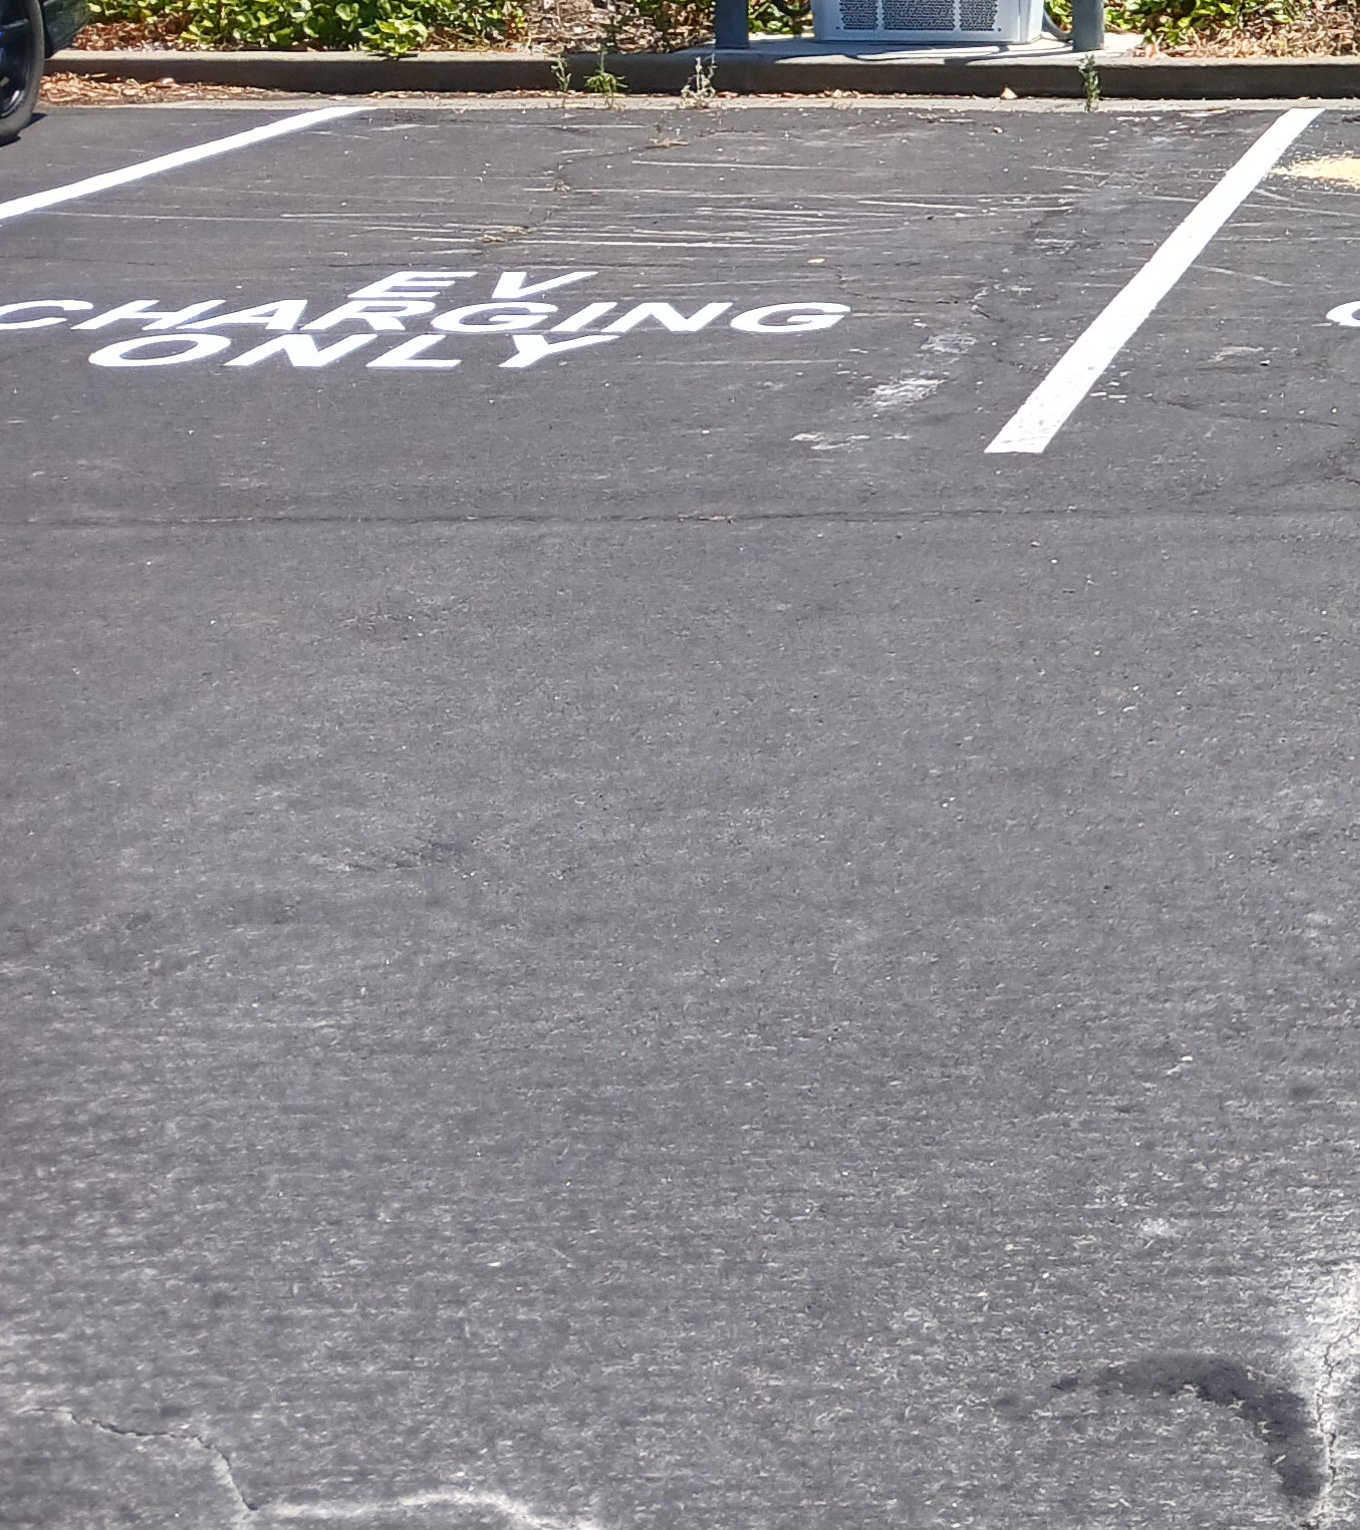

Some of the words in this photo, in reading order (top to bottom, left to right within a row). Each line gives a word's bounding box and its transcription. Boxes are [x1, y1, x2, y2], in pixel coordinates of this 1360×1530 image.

[349, 270, 599, 300] EV
[0, 299, 852, 334] CHARGING
[88, 333, 620, 370] ONLY
